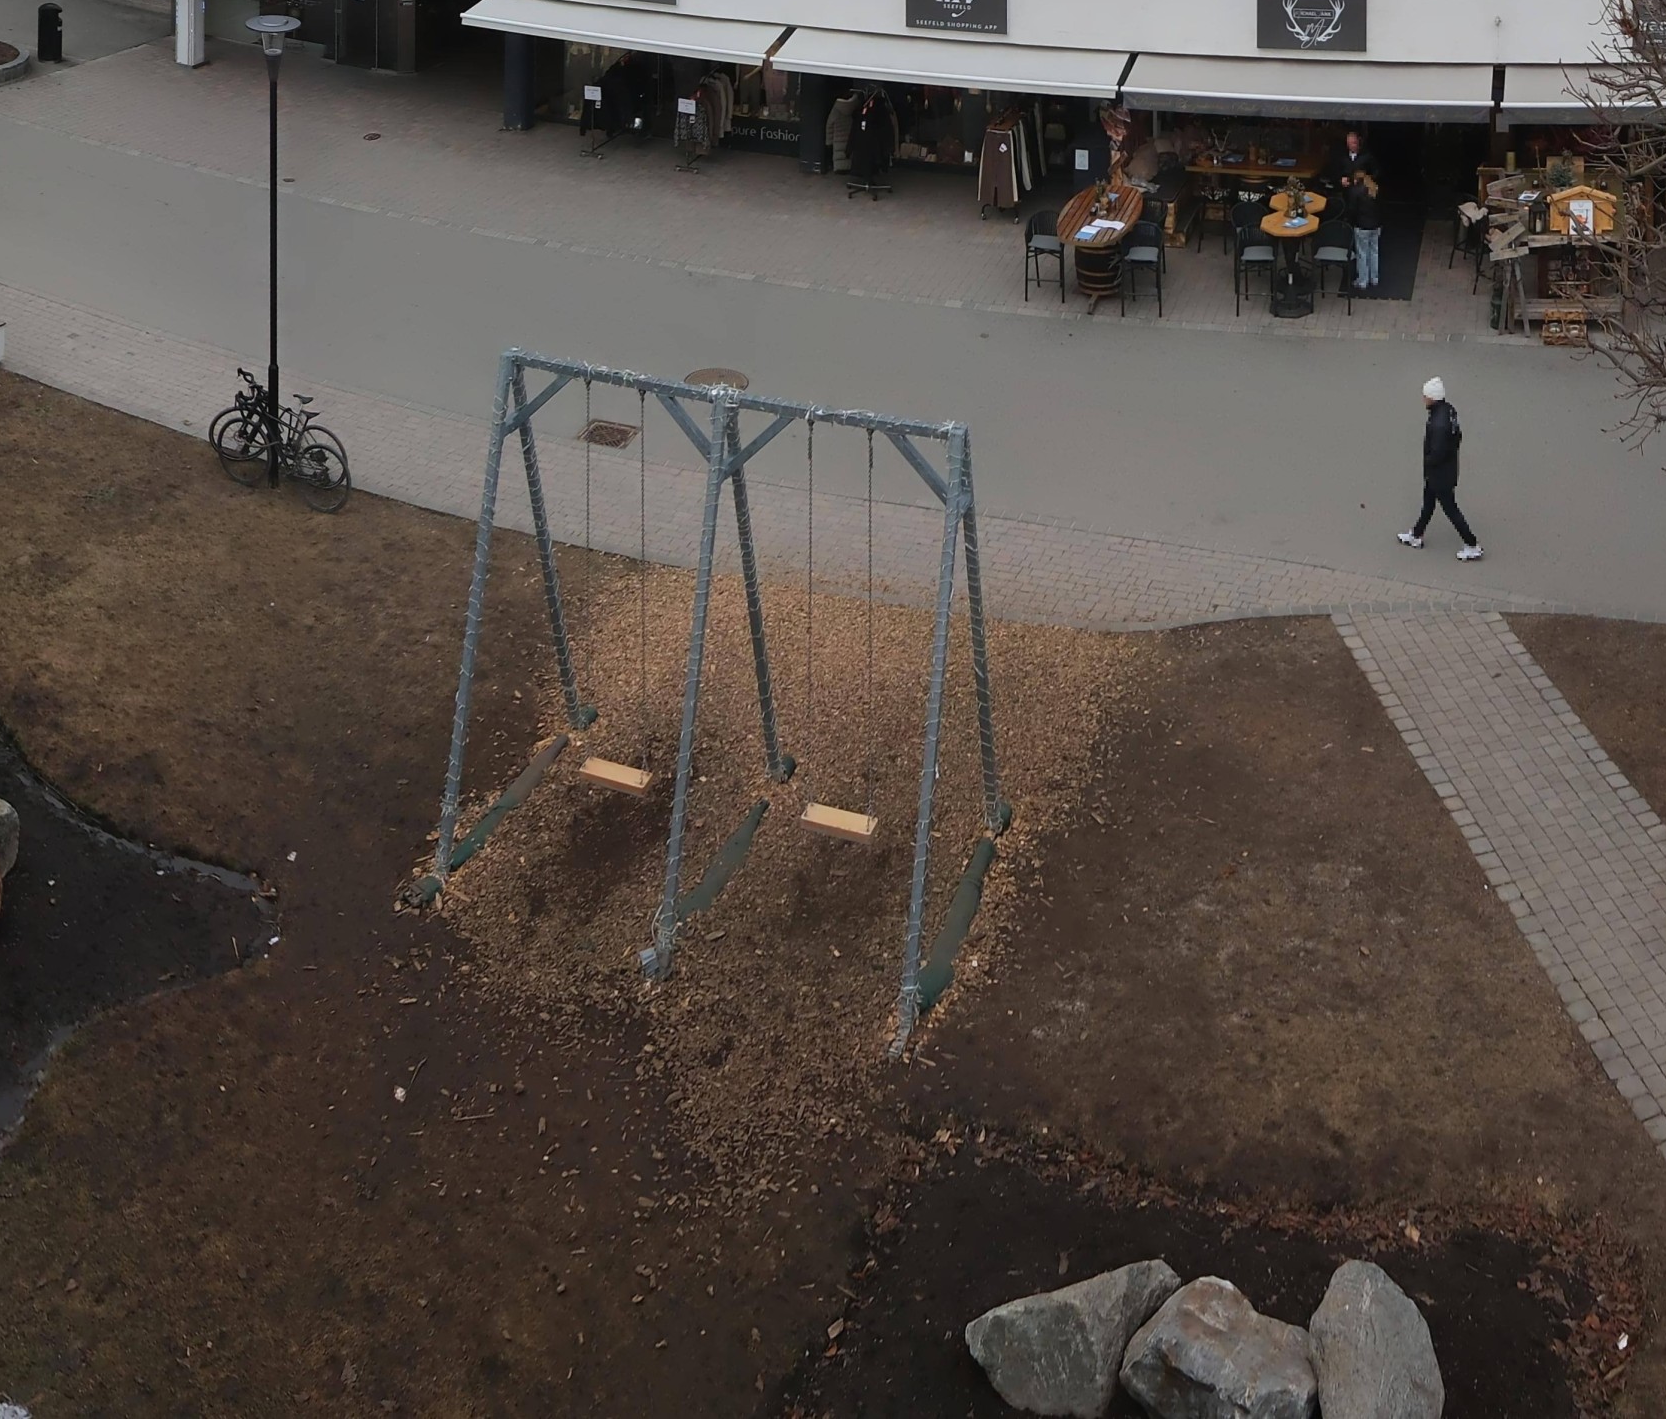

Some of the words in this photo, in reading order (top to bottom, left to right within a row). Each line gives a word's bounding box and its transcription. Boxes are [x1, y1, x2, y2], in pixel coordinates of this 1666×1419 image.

[943, 3, 972, 11] SEEFELD
[916, 19, 945, 27] SEEFELD
[947, 21, 982, 29] SHOPPING
